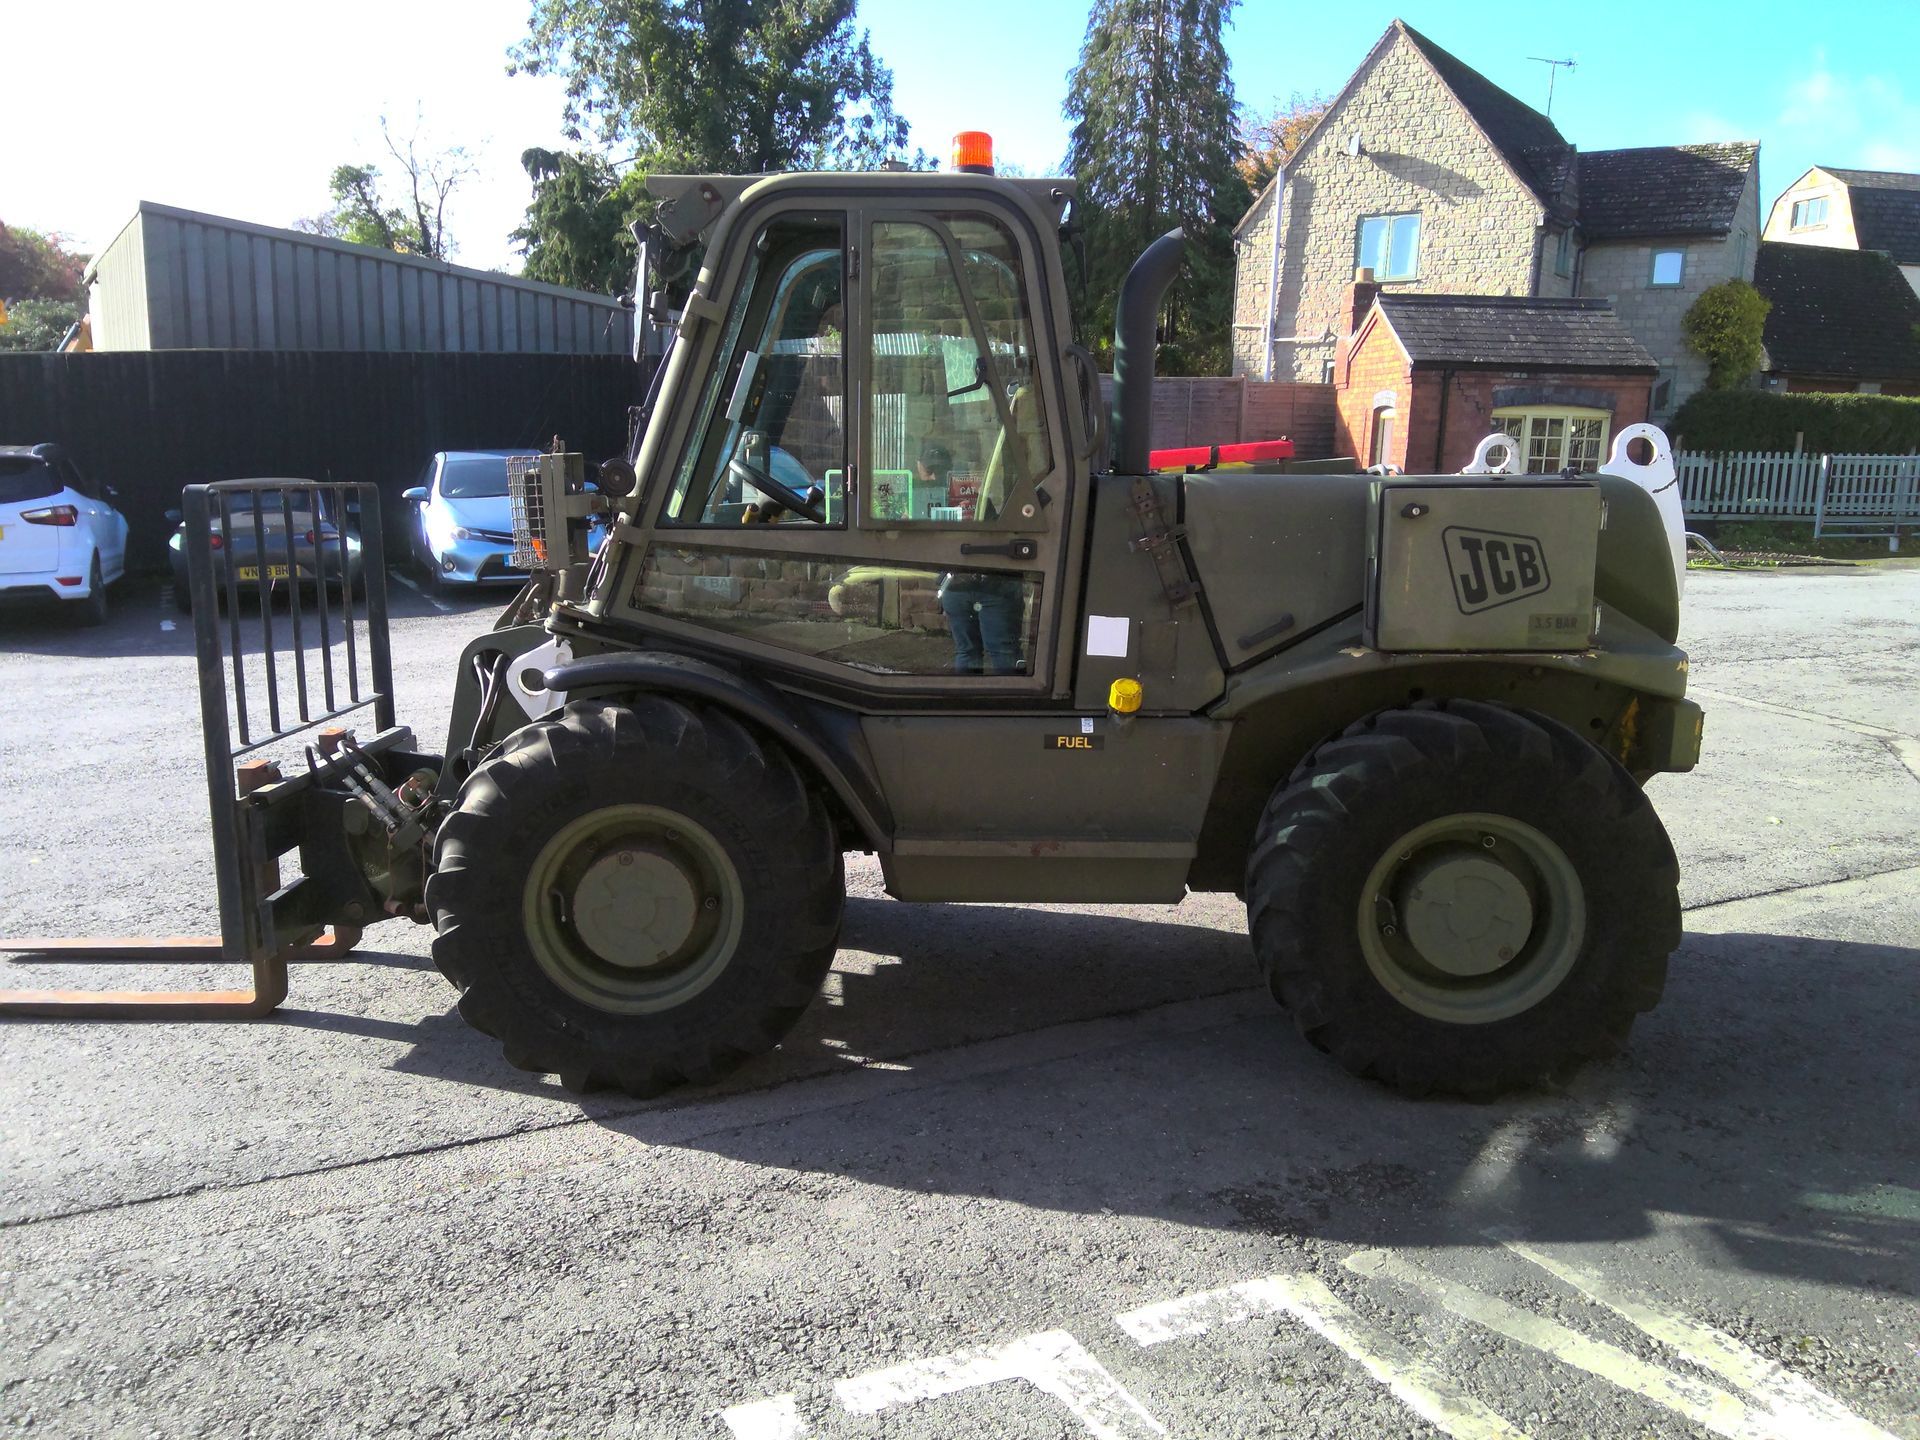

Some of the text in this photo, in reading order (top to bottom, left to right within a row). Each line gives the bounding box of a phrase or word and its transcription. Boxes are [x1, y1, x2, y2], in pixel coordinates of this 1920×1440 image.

[1460, 536, 1541, 604] JCB
[1555, 616, 1578, 629] BAR
[1057, 736, 1093, 749] FUEL
